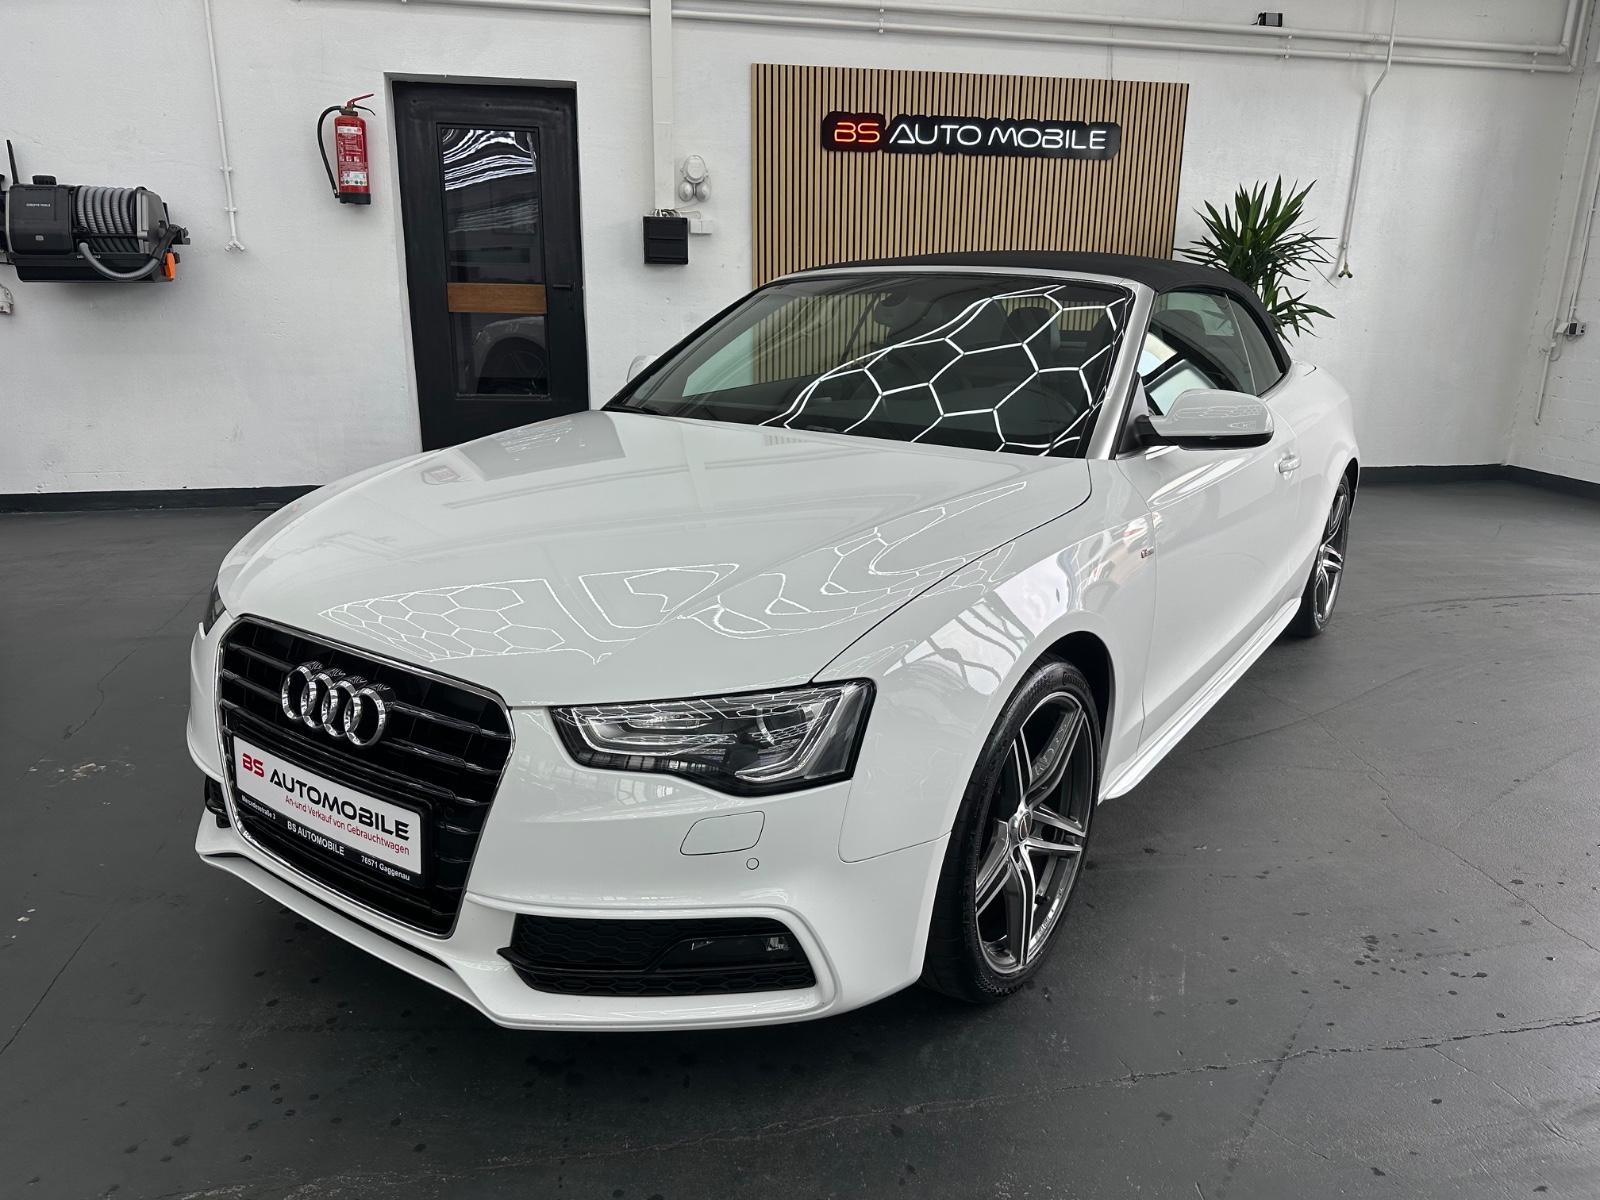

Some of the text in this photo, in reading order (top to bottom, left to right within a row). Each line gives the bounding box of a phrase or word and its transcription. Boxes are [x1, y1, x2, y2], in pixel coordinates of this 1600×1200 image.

[834, 122, 1107, 150] BS AUTO MOBILE
[242, 753, 410, 841] BS AUTOMOBILE
[287, 820, 345, 857] BS AUTOMOBILE
[307, 806, 332, 825] Verkauf
[333, 818, 346, 831] von
[346, 823, 410, 856] Gebrauchtwagen
[378, 863, 411, 882] Gaggenau
